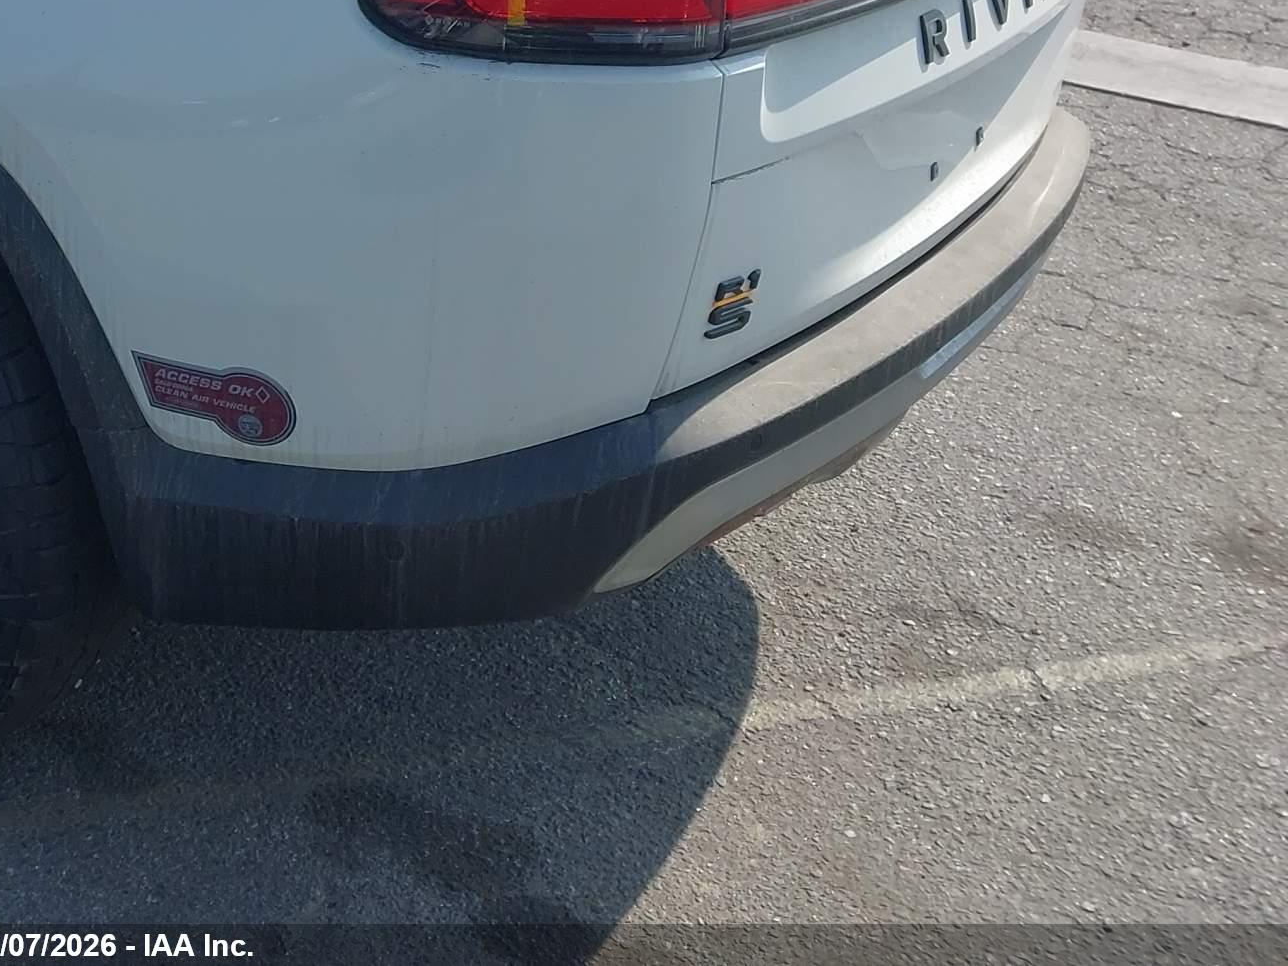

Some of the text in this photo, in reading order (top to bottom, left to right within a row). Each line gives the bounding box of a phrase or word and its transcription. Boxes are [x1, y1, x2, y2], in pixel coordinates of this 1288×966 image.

[154, 368, 255, 398] ACCESS OK
[154, 385, 189, 399] CLEAN
[191, 393, 209, 404] AIR
[212, 398, 256, 413] VEHICLE
